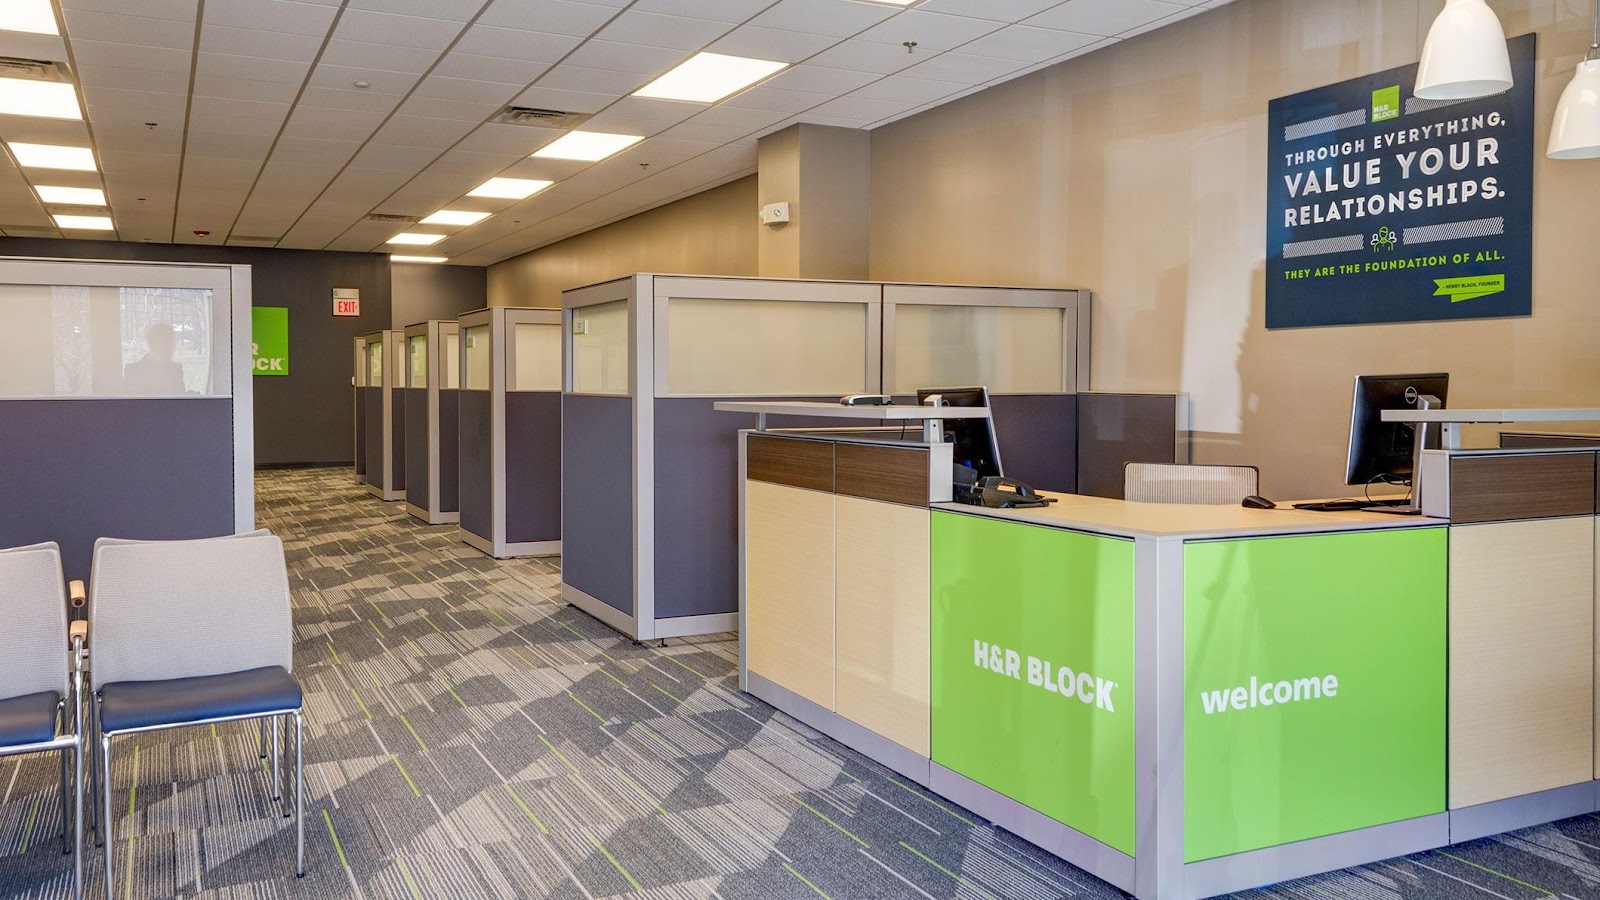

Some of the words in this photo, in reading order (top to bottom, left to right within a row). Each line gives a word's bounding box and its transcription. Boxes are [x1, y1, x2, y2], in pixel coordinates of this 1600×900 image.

[1373, 109, 1397, 119] BLOCK
[1285, 138, 1365, 167] THROUGH
[1373, 111, 1506, 149] EVERYTHING,
[1284, 158, 1381, 199] VALUE
[1396, 137, 1499, 180] YOUR
[1284, 176, 1506, 228] RELATIONSHIPS.
[1284, 269, 1311, 280] THEY
[1314, 266, 1335, 277] ARE
[1339, 264, 1361, 275] THE
[1365, 255, 1447, 272] FOUNDATION
[1452, 252, 1470, 264] OF
[1475, 249, 1506, 261] ALL.
[338, 301, 356, 313] EXIT
[973, 638, 1021, 681] H&R
[1027, 655, 1115, 713] BLOCK
[1200, 673, 1340, 715] welcome
